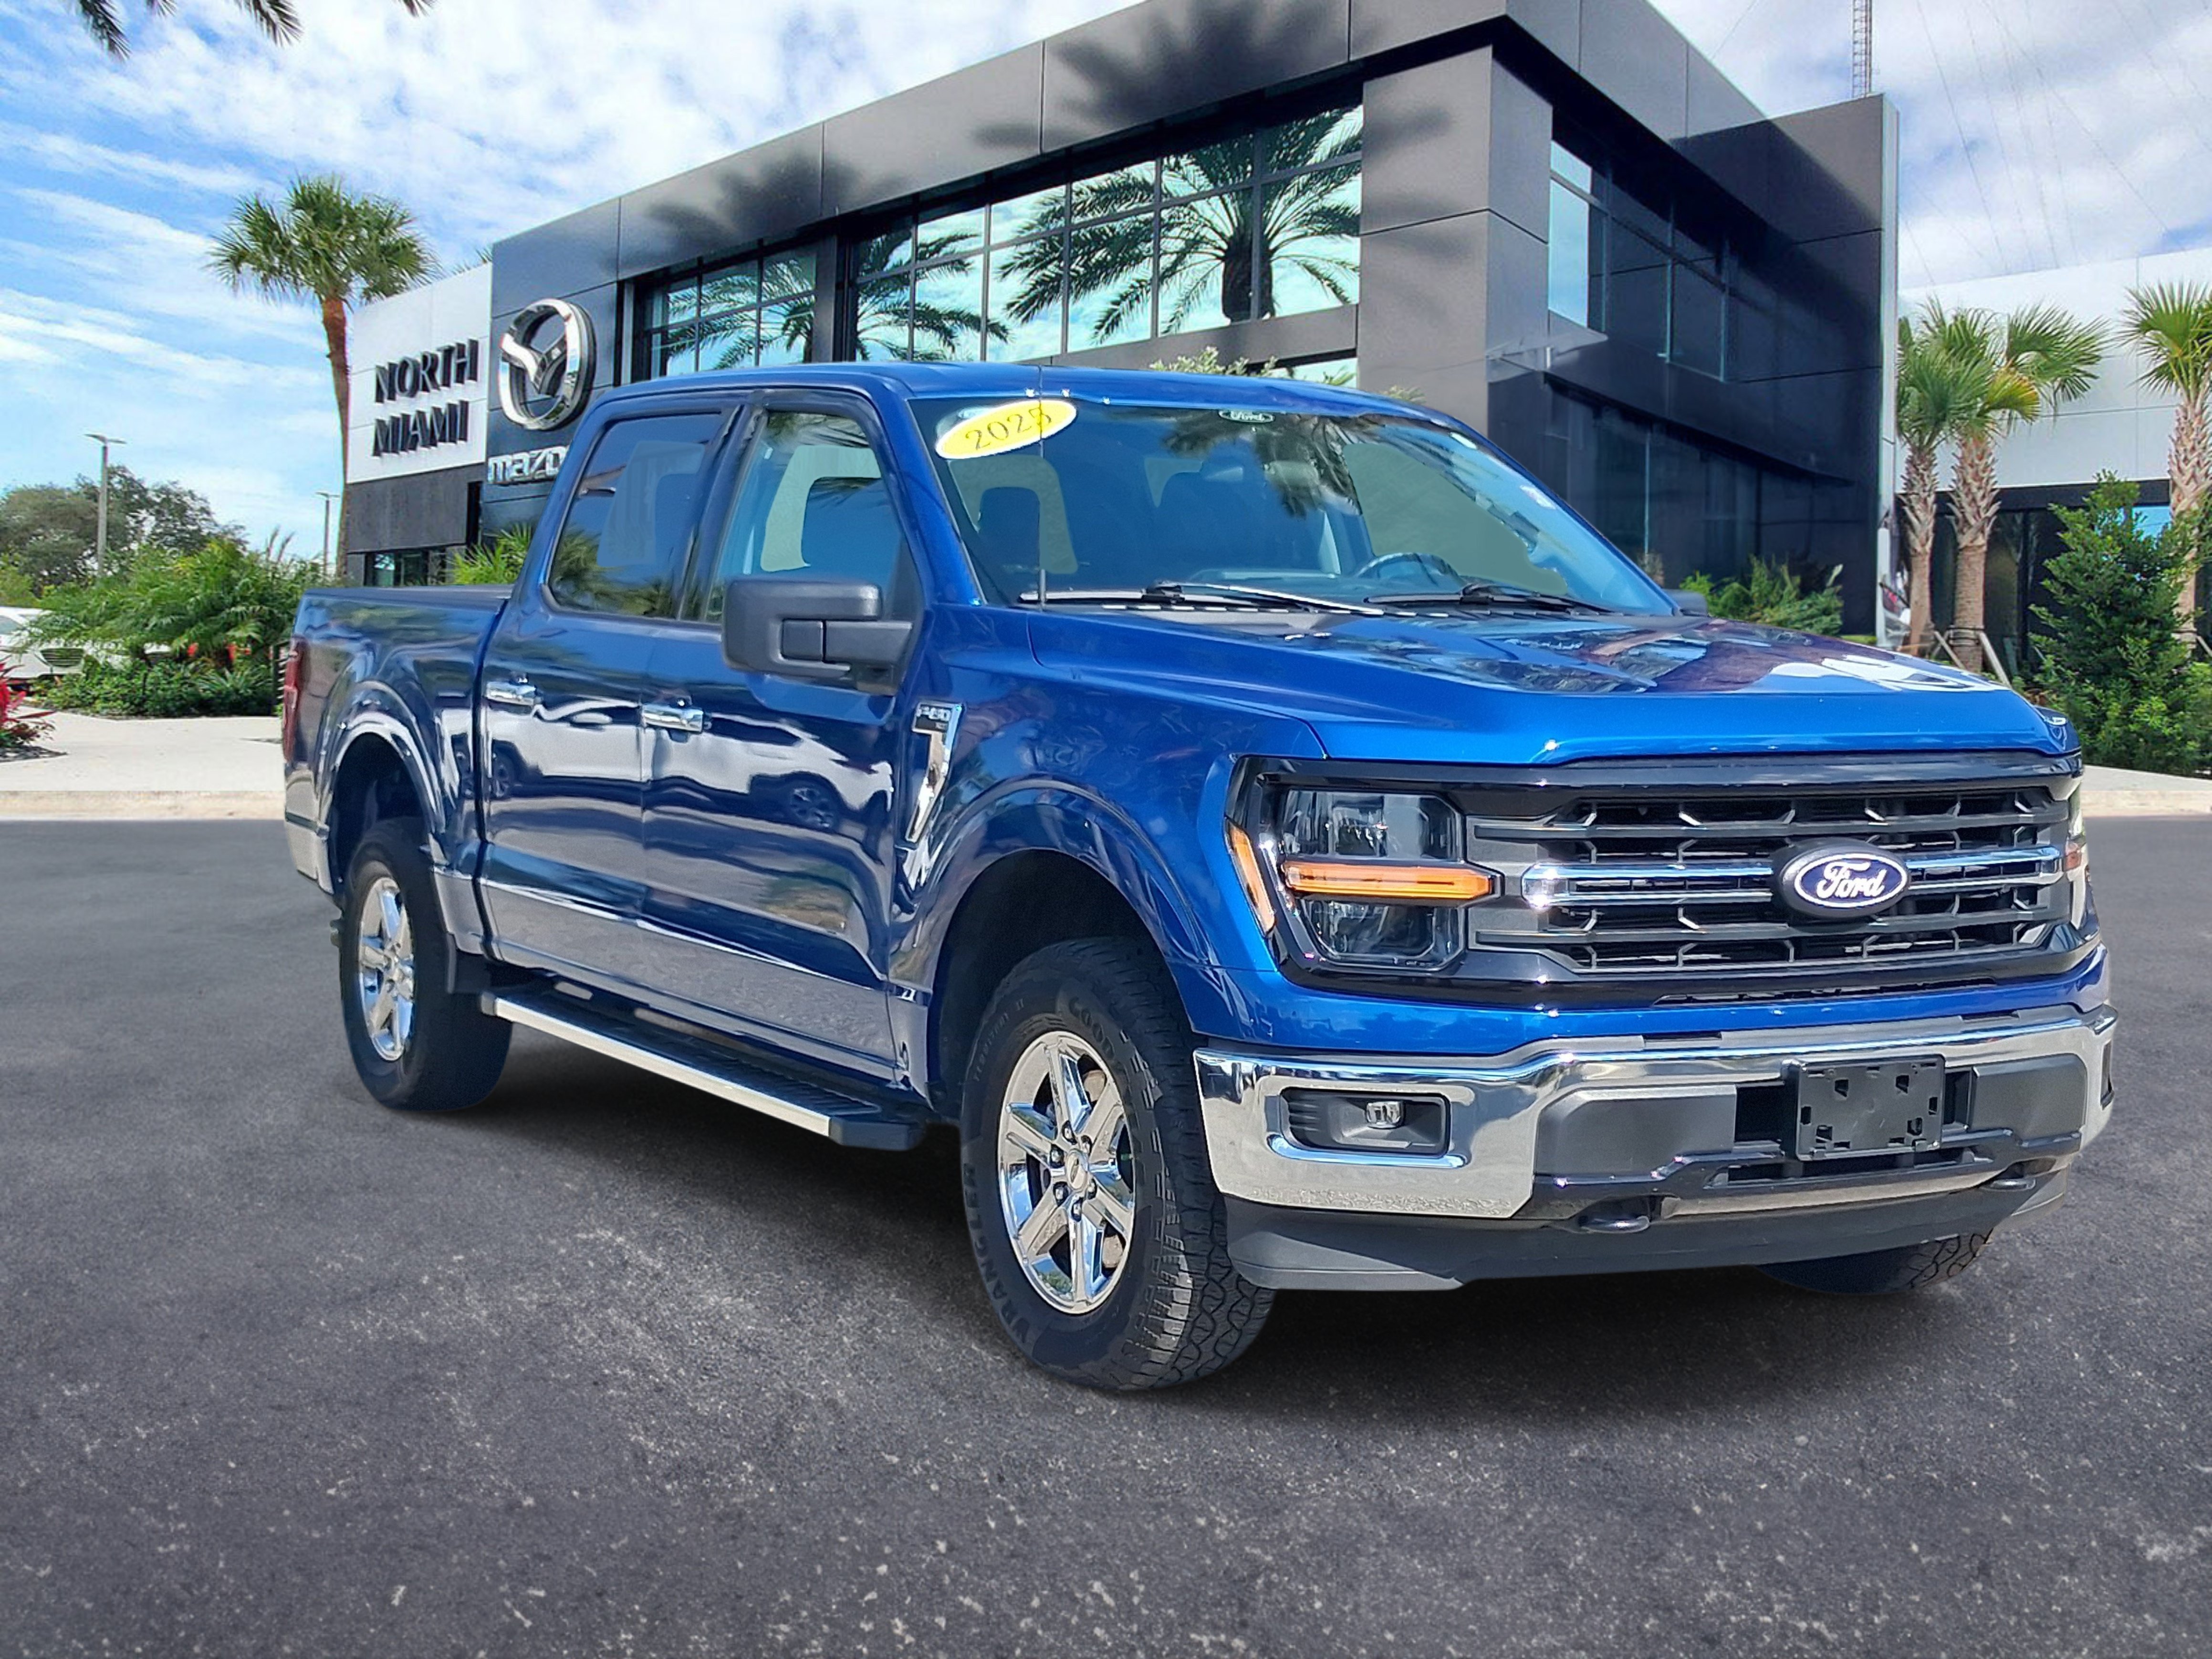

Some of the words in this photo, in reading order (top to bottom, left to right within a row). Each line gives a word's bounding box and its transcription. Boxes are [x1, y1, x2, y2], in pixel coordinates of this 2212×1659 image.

[376, 339, 479, 404] NORTH
[373, 400, 469, 456] MIAMI
[488, 446, 569, 483] mazd
[1816, 861, 1888, 898] Ford
